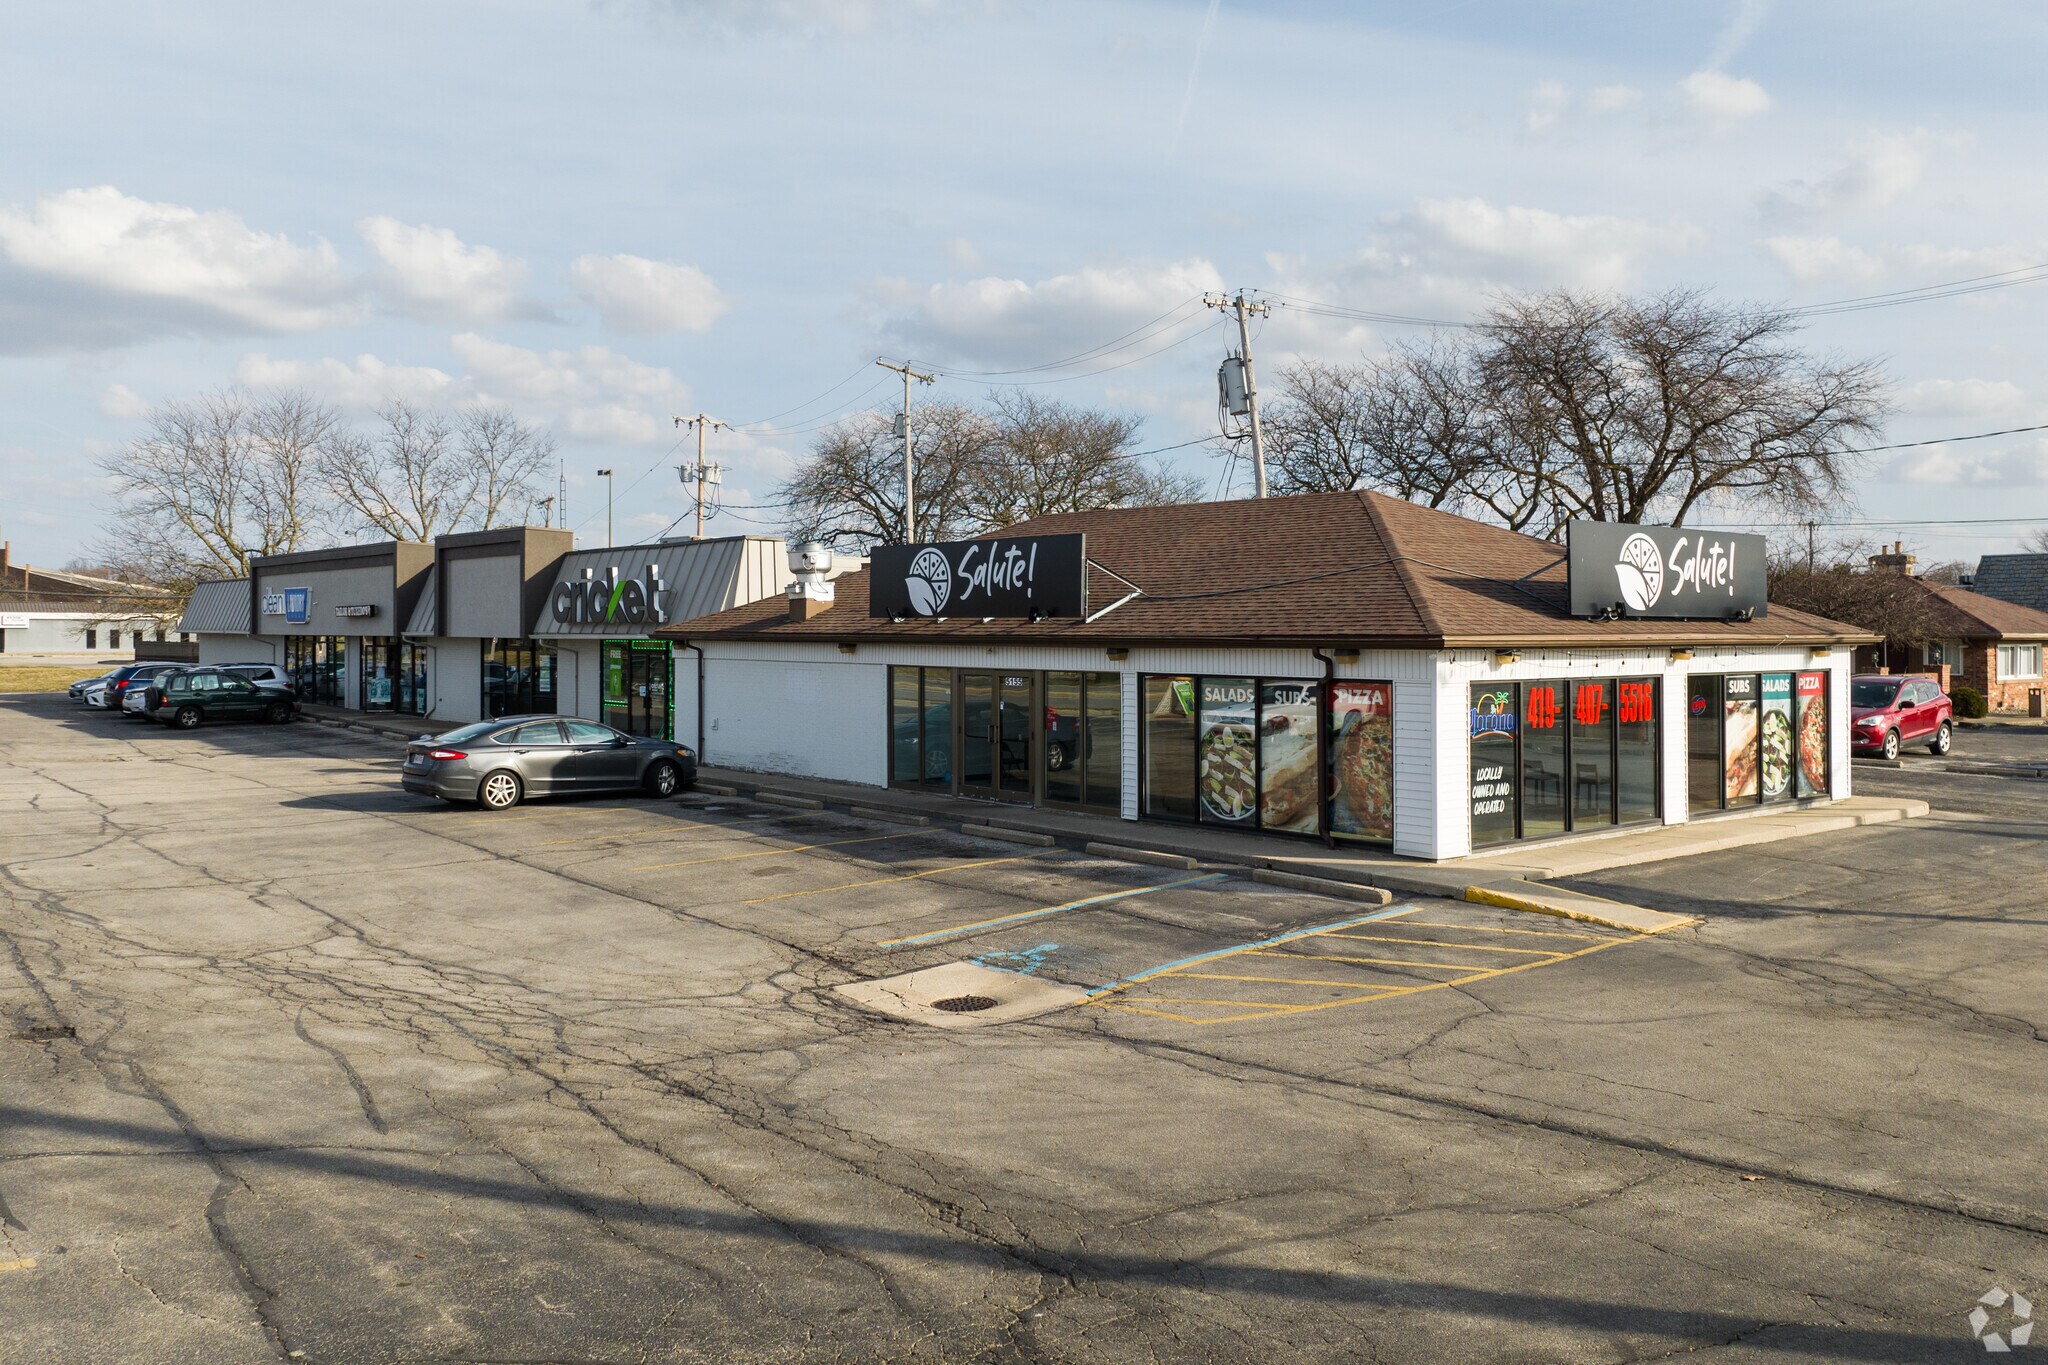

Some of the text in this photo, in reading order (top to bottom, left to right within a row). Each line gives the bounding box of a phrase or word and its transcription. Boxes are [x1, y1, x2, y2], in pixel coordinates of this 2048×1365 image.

[957, 540, 1038, 601] Salute!
[1668, 535, 1736, 597] Salute!
[552, 564, 670, 625] cricket
[1005, 677, 1023, 687] 5155
[1728, 679, 1750, 694] SUBS
[1762, 678, 1790, 693] SALADS
[1798, 676, 1820, 690] PIZZA
[1204, 687, 1255, 703] SALADS
[1274, 690, 1310, 705] SUBS
[1337, 688, 1384, 706] PIZZA
[1619, 682, 1653, 723] 5516
[1476, 766, 1504, 781] LOCALLY
[1472, 782, 1510, 799] OWNED AND
[1474, 799, 1505, 816] OPERATED
